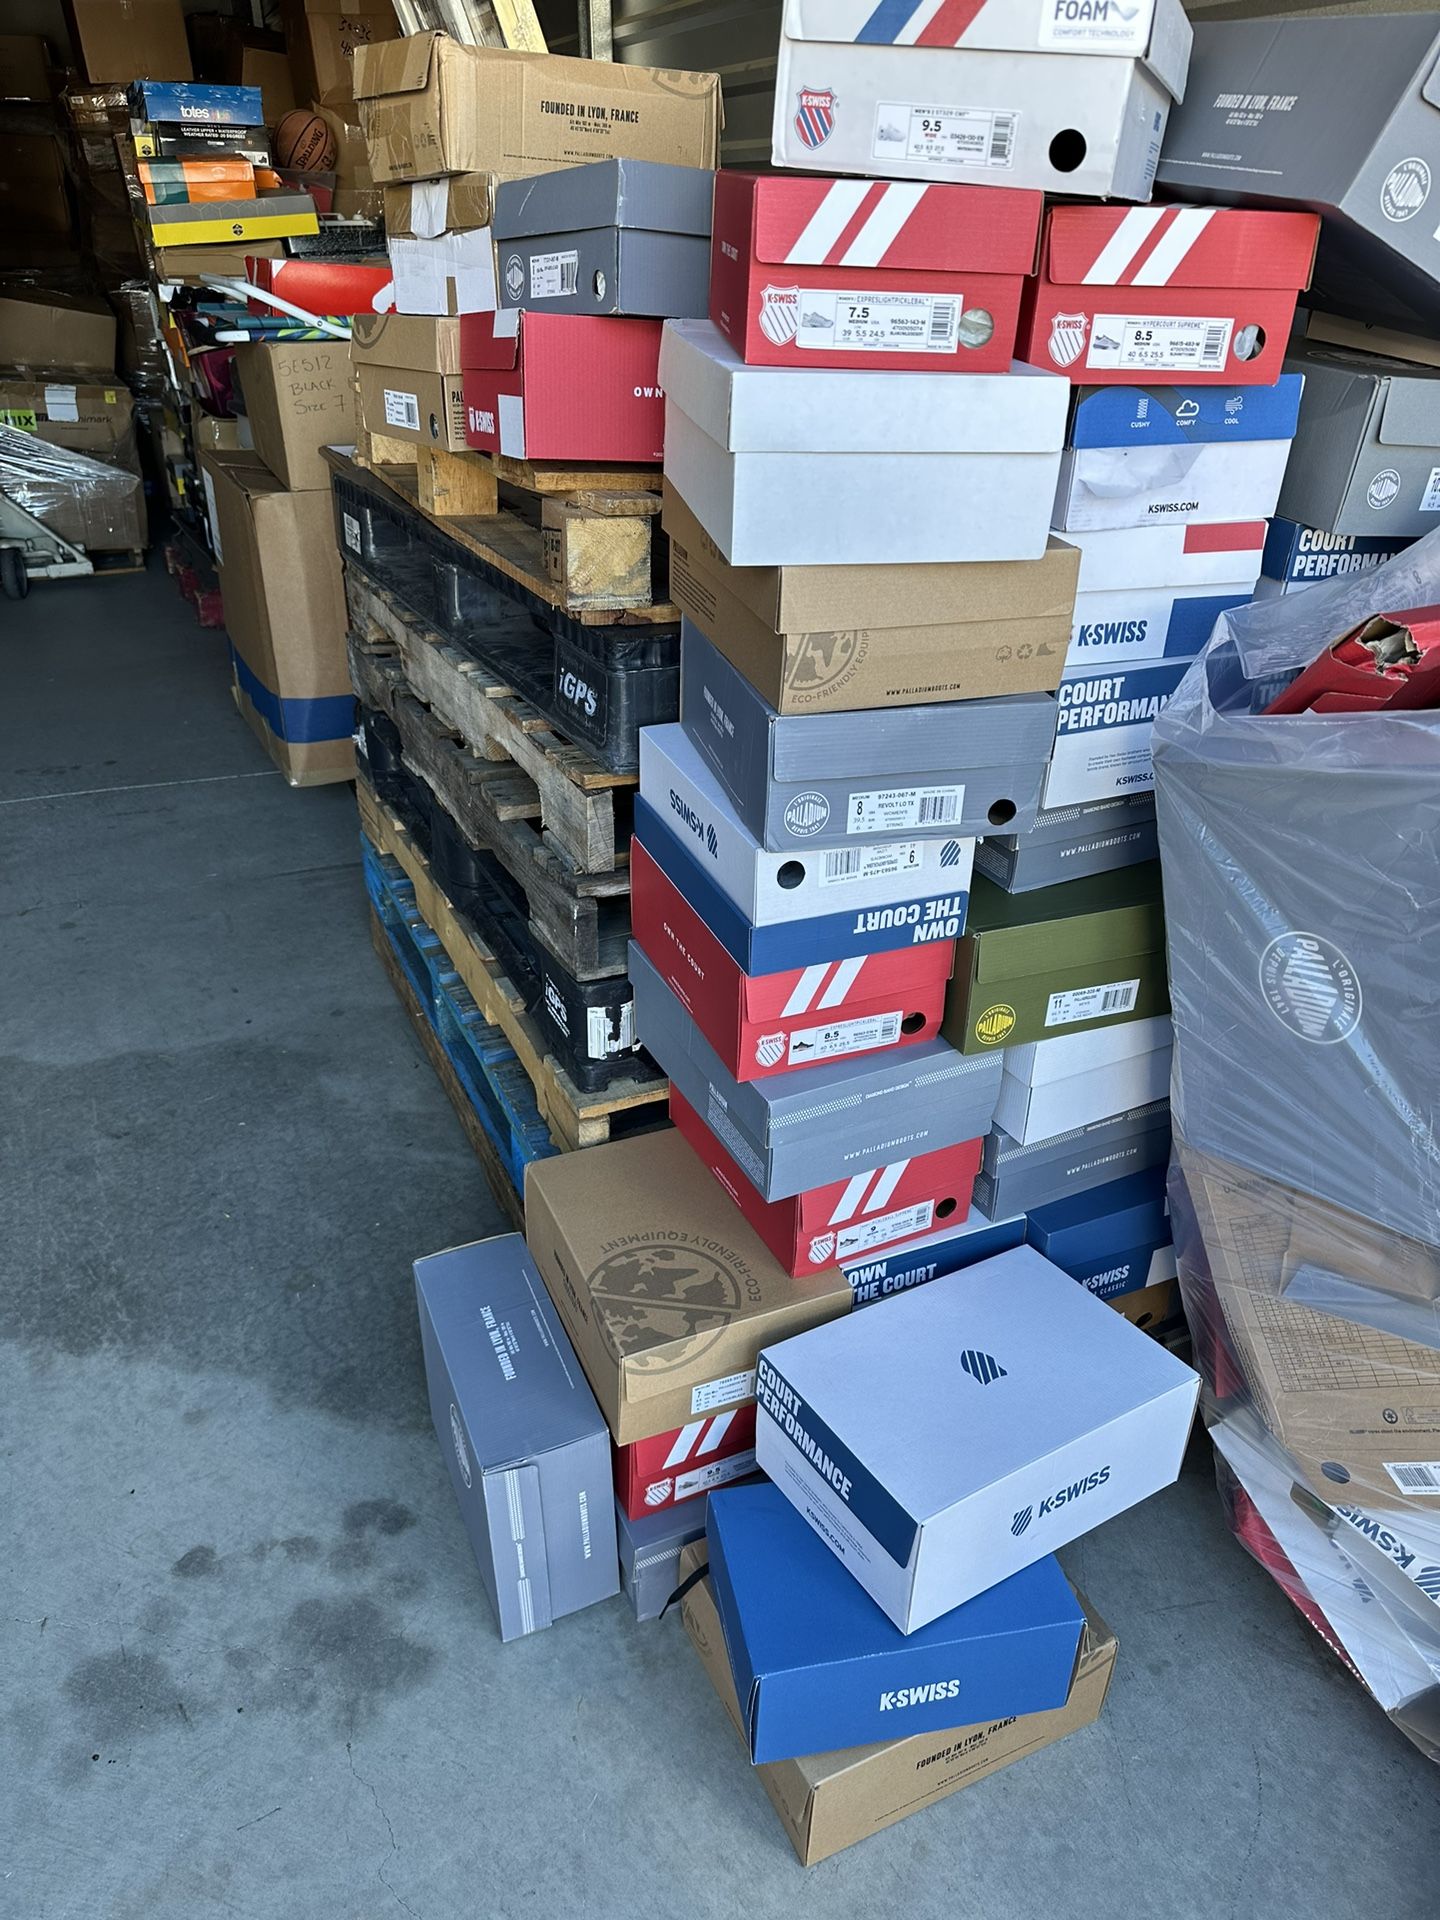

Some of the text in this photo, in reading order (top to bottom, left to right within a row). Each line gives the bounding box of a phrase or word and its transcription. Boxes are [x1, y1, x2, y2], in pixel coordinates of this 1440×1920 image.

[1054, 0, 1109, 21] FOAM
[180, 105, 210, 119] totes
[540, 100, 639, 123] FOUNDED IN LYON, FRANCE
[1213, 93, 1244, 108] FOUNDED
[1266, 95, 1298, 111] FRANCE
[922, 119, 942, 132] 9.5
[849, 306, 869, 318] 7.5
[842, 329, 852, 337] 39
[869, 330, 885, 338] 24.5
[1135, 330, 1153, 341] 8.5
[289, 378, 335, 397] BLACK
[634, 386, 663, 398] OWN
[334, 395, 345, 413] 7
[1176, 419, 1197, 427] COMFY
[1148, 502, 1199, 514] KSWISS.COM
[1298, 529, 1356, 551] COURT
[1292, 552, 1396, 577] PERFORMA
[791, 629, 870, 704] ECO-FRIENDLY EQUIP
[558, 668, 597, 716] iGPS
[1059, 677, 1125, 707] COURT
[787, 802, 827, 827] PALLADIUM
[857, 800, 863, 815] 8
[1060, 832, 1141, 858] WWW.PALLADIUMBOOTS.COM
[853, 896, 961, 934] THE COURT
[913, 918, 959, 943] OWN
[664, 922, 705, 980] OWN THE COURT
[1266, 947, 1290, 1015] DEPUIS 1947
[1283, 938, 1339, 1037] PALLADIUM
[1054, 999, 1063, 1009] 11
[1332, 959, 1355, 1031] L'ORIGINALE
[824, 1030, 839, 1039] 8.5
[844, 1130, 929, 1160] WWW.PALLADIUMBOOTS.COM
[600, 1230, 762, 1302] ECO-FRIENDLY EQUIPMENT
[848, 1262, 887, 1287] OWN
[853, 1263, 937, 1304] THE COURT
[1100, 1281, 1126, 1295] CLASSIC
[480, 1305, 496, 1330] FRANCE
[498, 1353, 517, 1381] FOUNDED
[758, 1359, 802, 1418] COURT
[756, 1377, 852, 1501] PERFORMANCE
[806, 1506, 846, 1555] KSWISS.COM
[916, 1747, 951, 1770] FOUNDED
[953, 1741, 962, 1752] IN
[964, 1731, 985, 1748] LYON,
[987, 1716, 1017, 1735] FRANCE
